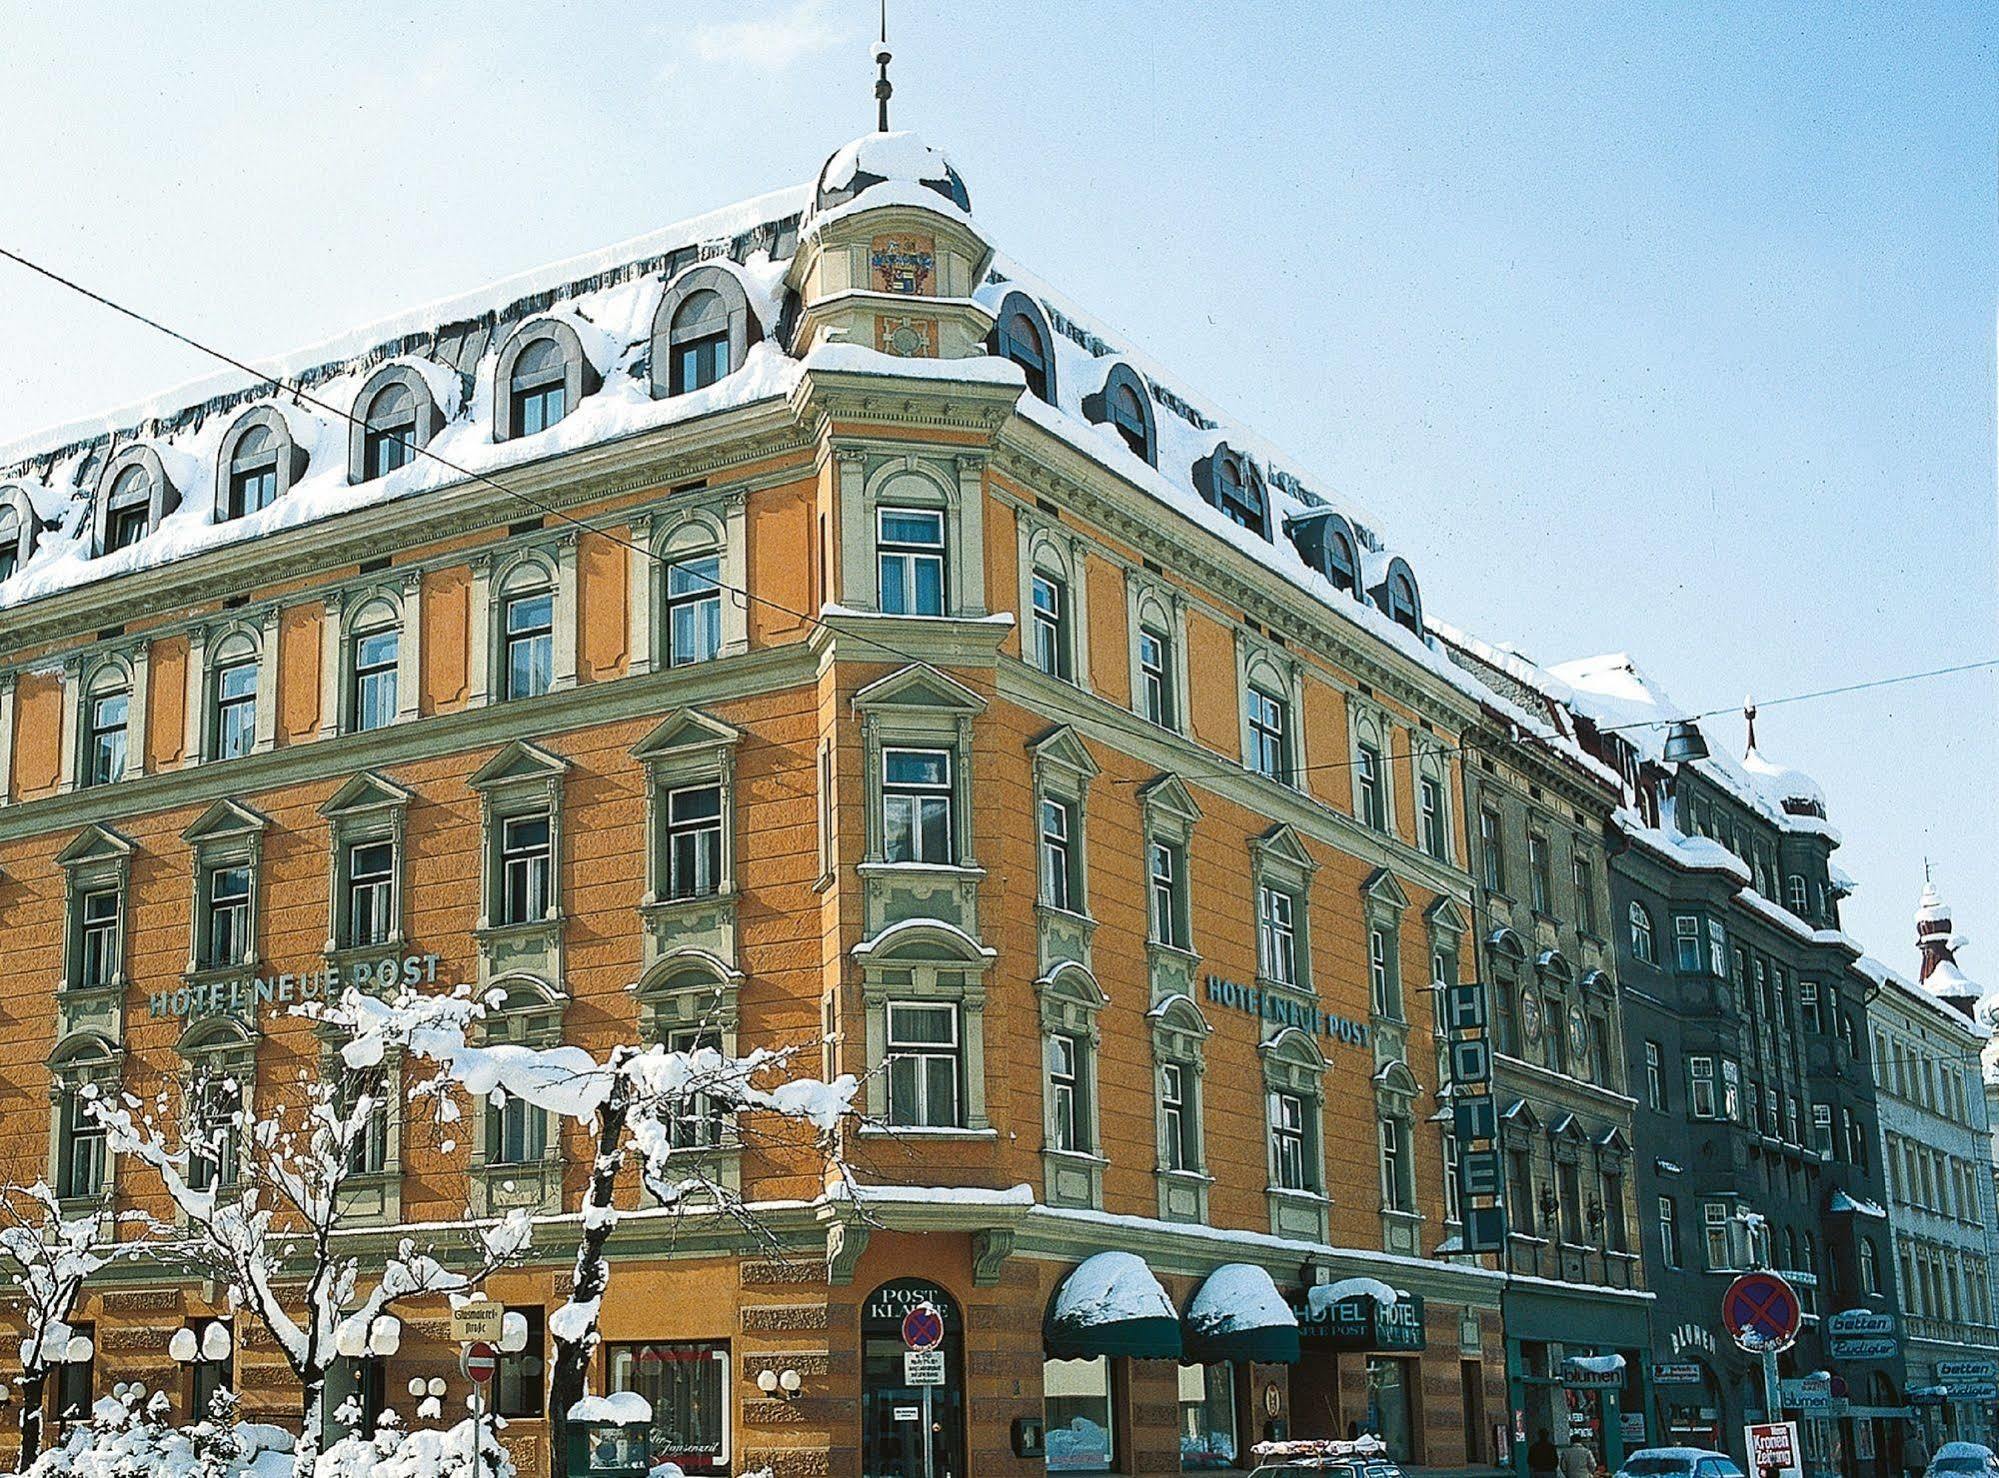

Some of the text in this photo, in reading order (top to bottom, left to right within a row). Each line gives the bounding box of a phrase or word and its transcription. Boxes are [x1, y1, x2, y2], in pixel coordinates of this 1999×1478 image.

[150, 954, 440, 1018] HOTEL NEUE POST
[1207, 974, 1371, 1047] HOTEL NEUE POST
[1451, 986, 1500, 1251] HOTEL
[882, 1289, 938, 1304] POST
[872, 1304, 948, 1318] KLAE
[1294, 1303, 1367, 1323] HOTEL
[1379, 1303, 1421, 1327] HOTEL
[1332, 1325, 1369, 1336] POST
[1671, 1323, 1716, 1355] BLUMEN
[1564, 1366, 1620, 1383] blumen
[1783, 1390, 1828, 1407] blumen
[1753, 1434, 1789, 1451] Kronen
[1756, 1450, 1791, 1467] Zeitung
